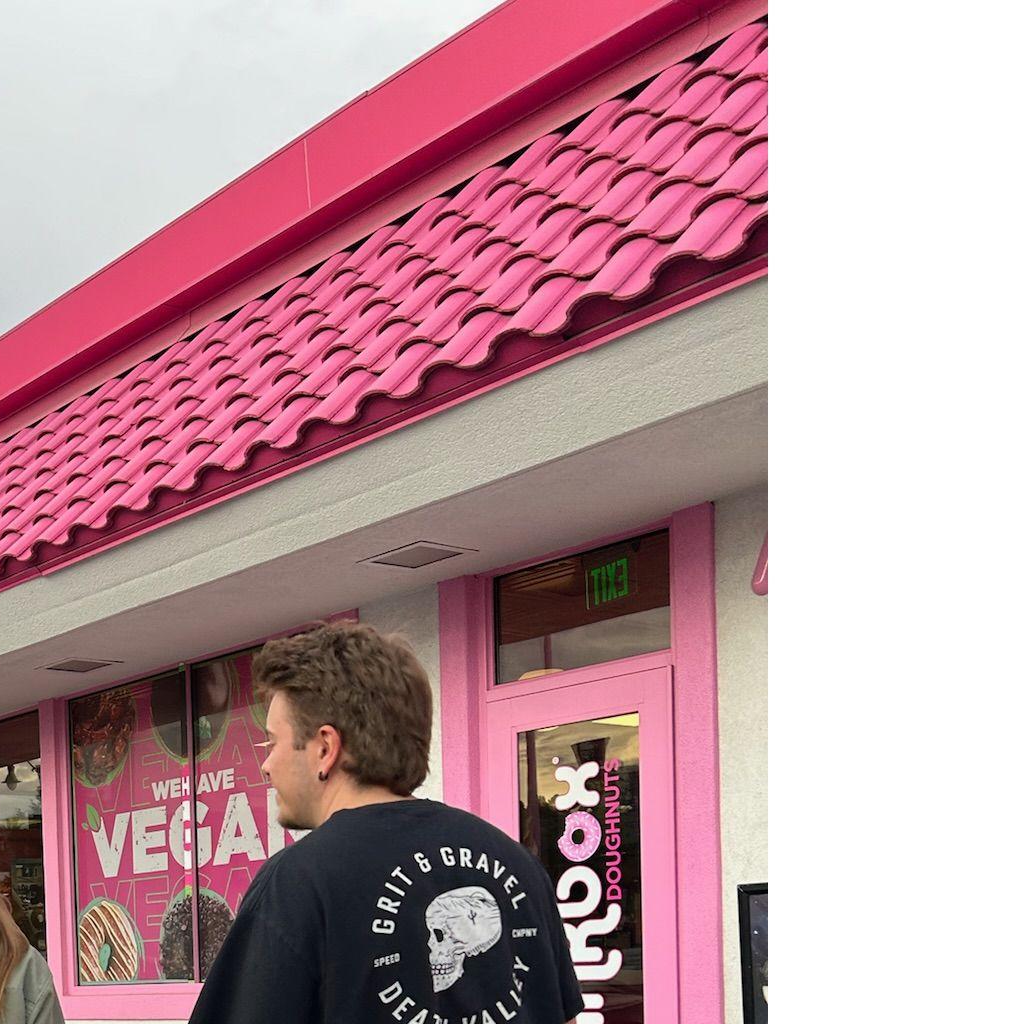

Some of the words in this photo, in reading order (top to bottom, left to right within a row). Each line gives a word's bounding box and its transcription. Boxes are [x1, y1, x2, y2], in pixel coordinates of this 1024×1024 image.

[604, 757, 623, 901] DOUGHNUTS
[372, 866, 413, 934] GRIT
[414, 852, 432, 873] &
[440, 847, 526, 909] GRAVEL
[374, 953, 400, 967] SPEED
